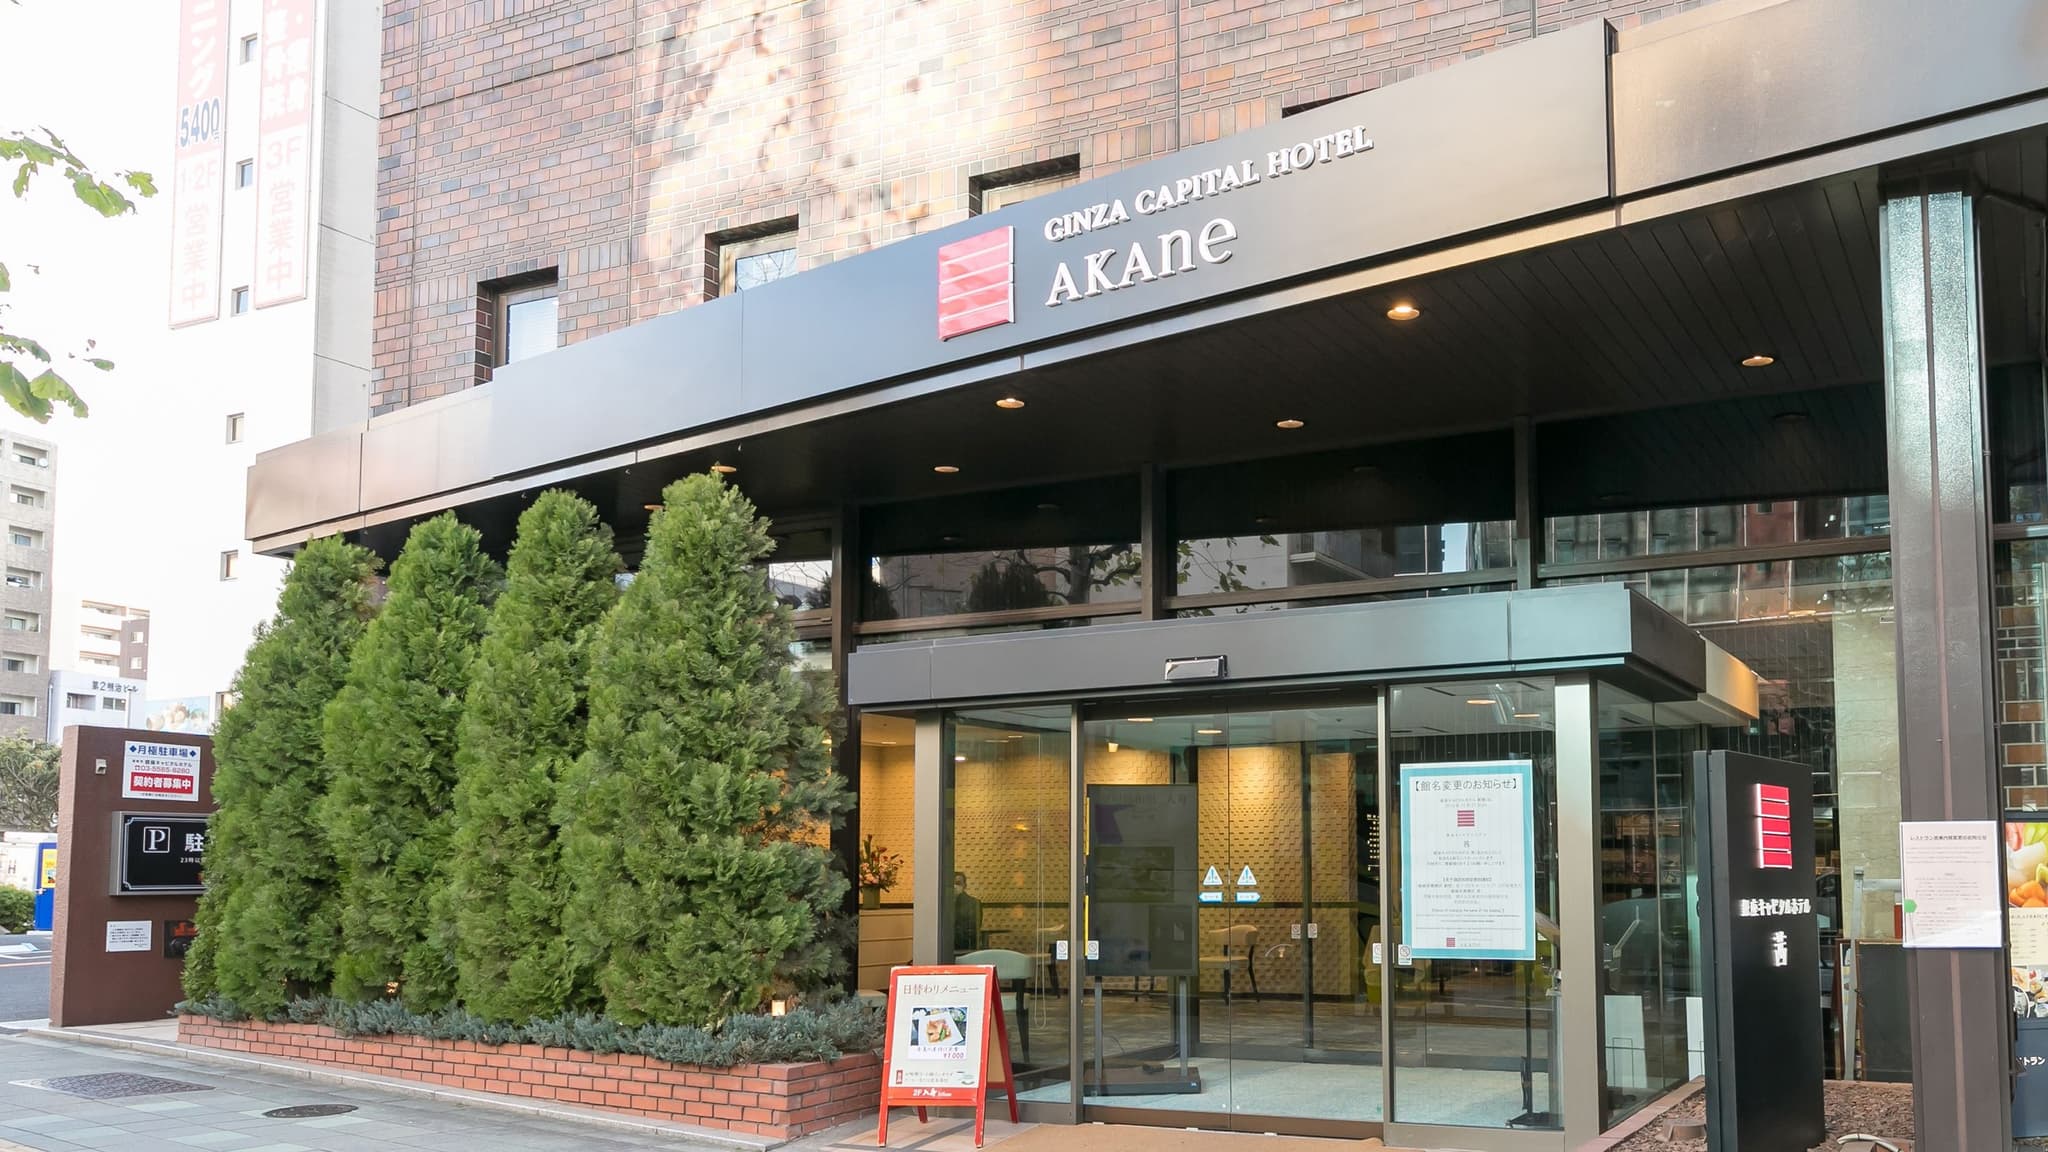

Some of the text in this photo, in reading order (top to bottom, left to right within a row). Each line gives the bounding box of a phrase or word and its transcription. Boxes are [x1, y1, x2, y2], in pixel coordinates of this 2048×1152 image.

[266, 136, 302, 170] 3F
[1044, 125, 1374, 242] GINZA CAPITAL HOTEL
[266, 177, 297, 292] 営業中
[137, 745, 189, 758] 月極駐車場
[133, 776, 191, 790] 契約者募集中
[148, 829, 166, 850] P
[903, 984, 980, 996] 日替わりメニュー
